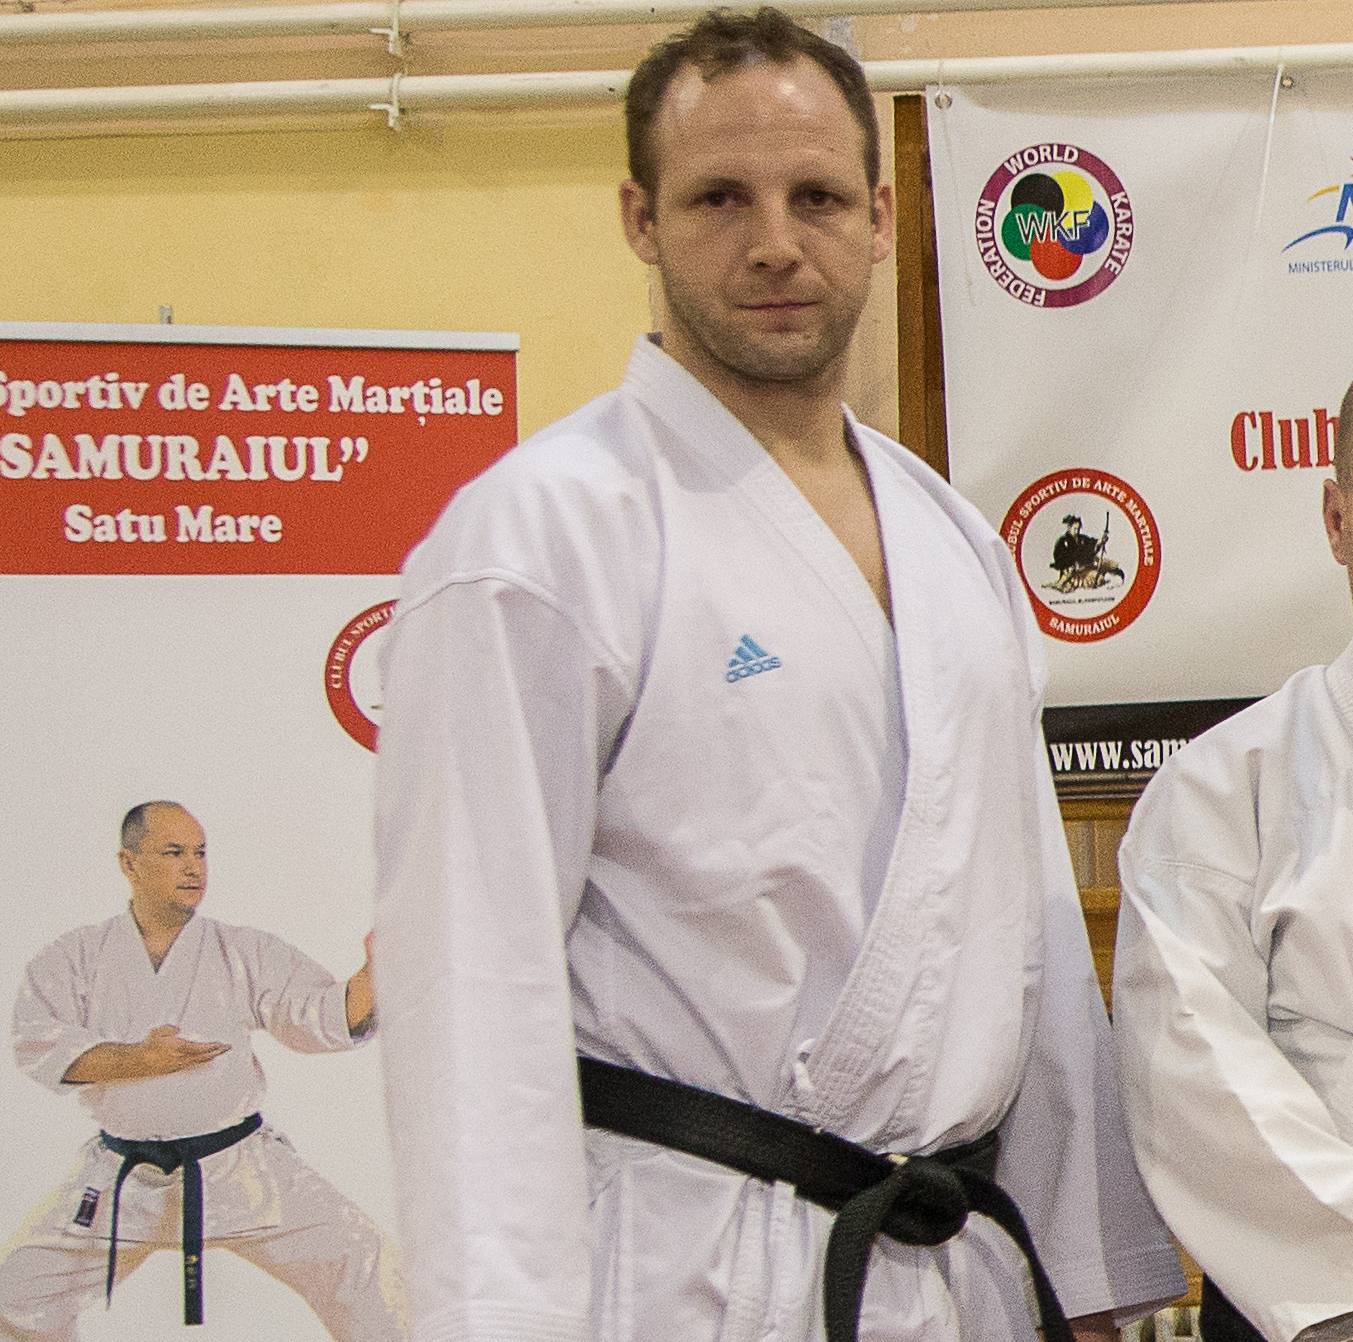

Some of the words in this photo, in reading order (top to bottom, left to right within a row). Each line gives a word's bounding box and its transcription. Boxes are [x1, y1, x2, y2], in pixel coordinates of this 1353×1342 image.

[1003, 144, 1080, 176] WORLD
[1014, 209, 1092, 245] WKF
[1110, 190, 1134, 276] KARATE
[975, 198, 1047, 308] FEDERATION
[157, 373, 211, 410] de
[217, 373, 319, 413] Arte
[62, 504, 168, 543] Satu
[173, 504, 283, 543] Mare
[1018, 479, 1069, 519] SPORTIV
[1071, 477, 1091, 489] DE
[1093, 479, 1128, 503] ARTE
[1125, 499, 1155, 567] MARTIALE
[1049, 613, 1121, 637] SAMURAIUL
